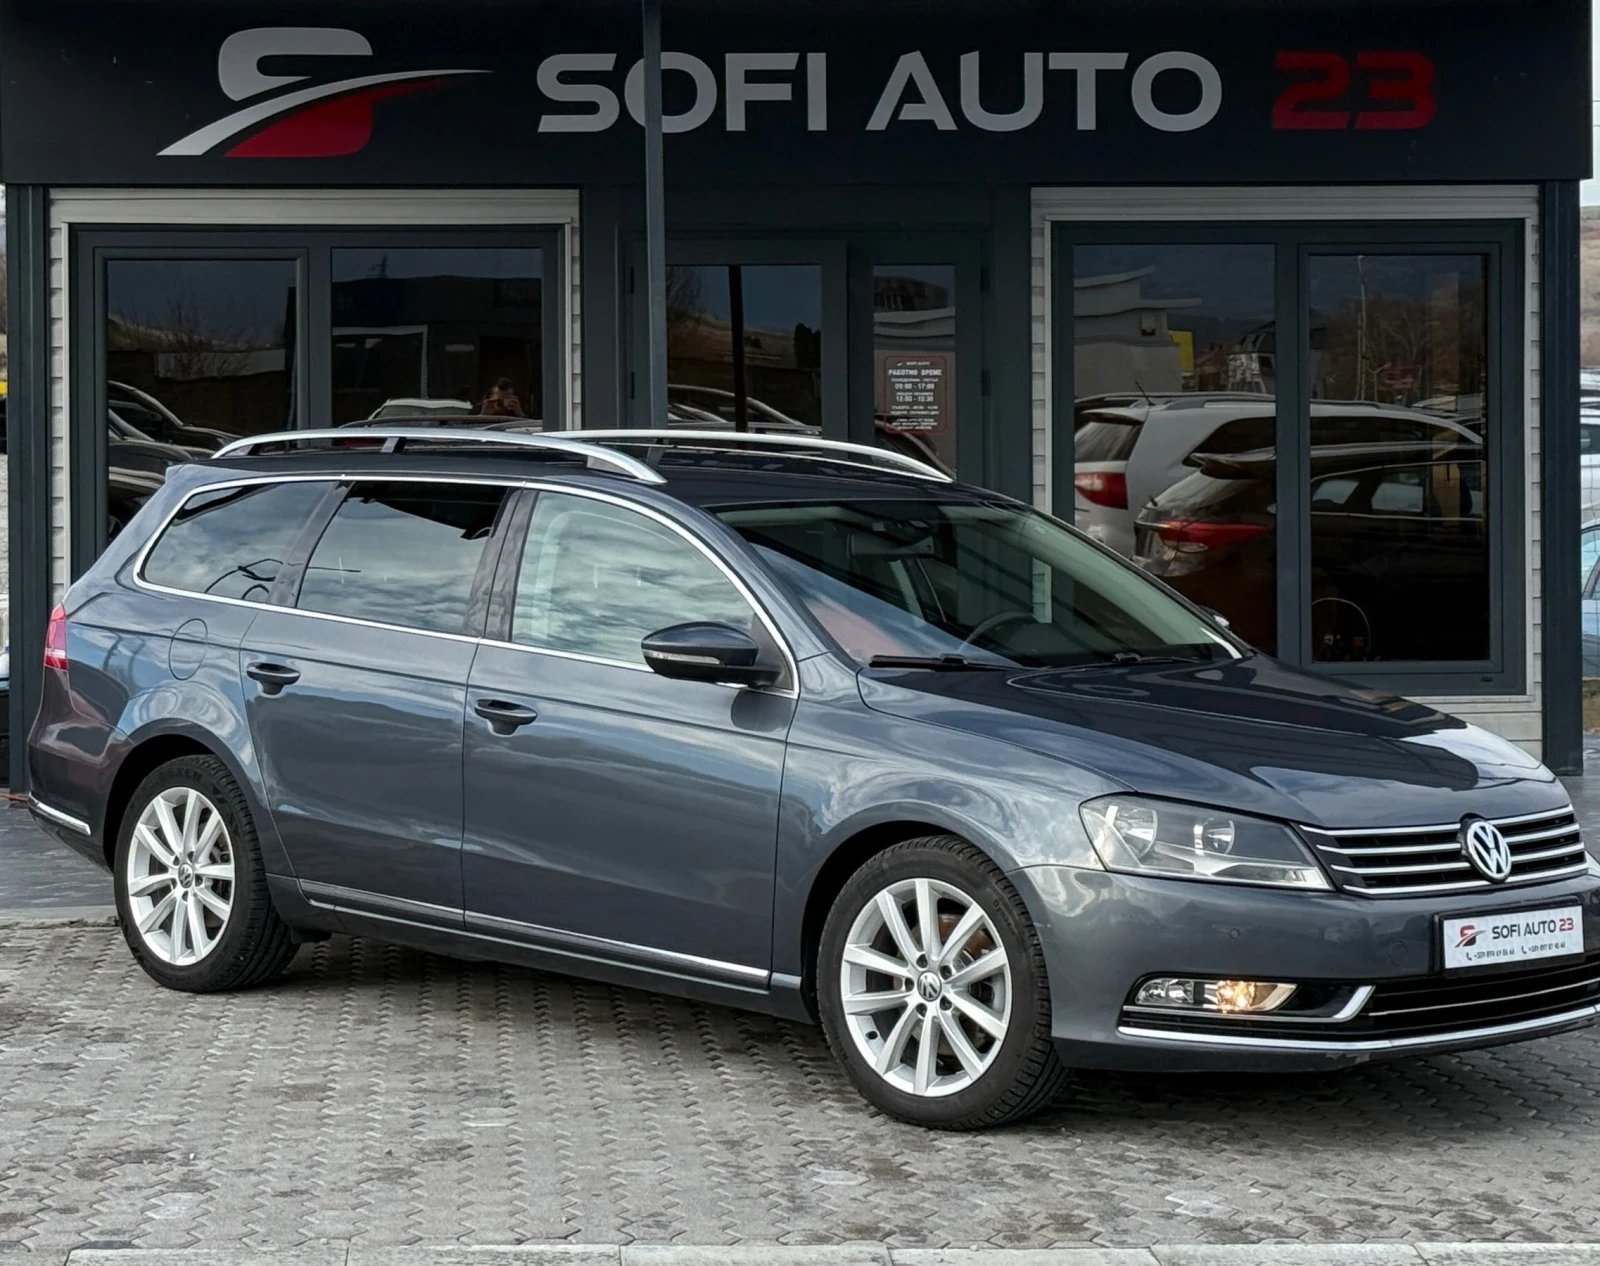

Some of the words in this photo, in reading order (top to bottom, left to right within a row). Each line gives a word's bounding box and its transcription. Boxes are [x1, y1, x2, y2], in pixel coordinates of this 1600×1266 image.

[536, 51, 827, 134] SOFI
[865, 50, 1223, 132] AUTO
[1271, 51, 1437, 130] 23
[1492, 923, 1521, 940] SOFI
[1523, 920, 1557, 937] AUTO
[1559, 917, 1574, 932] 23
